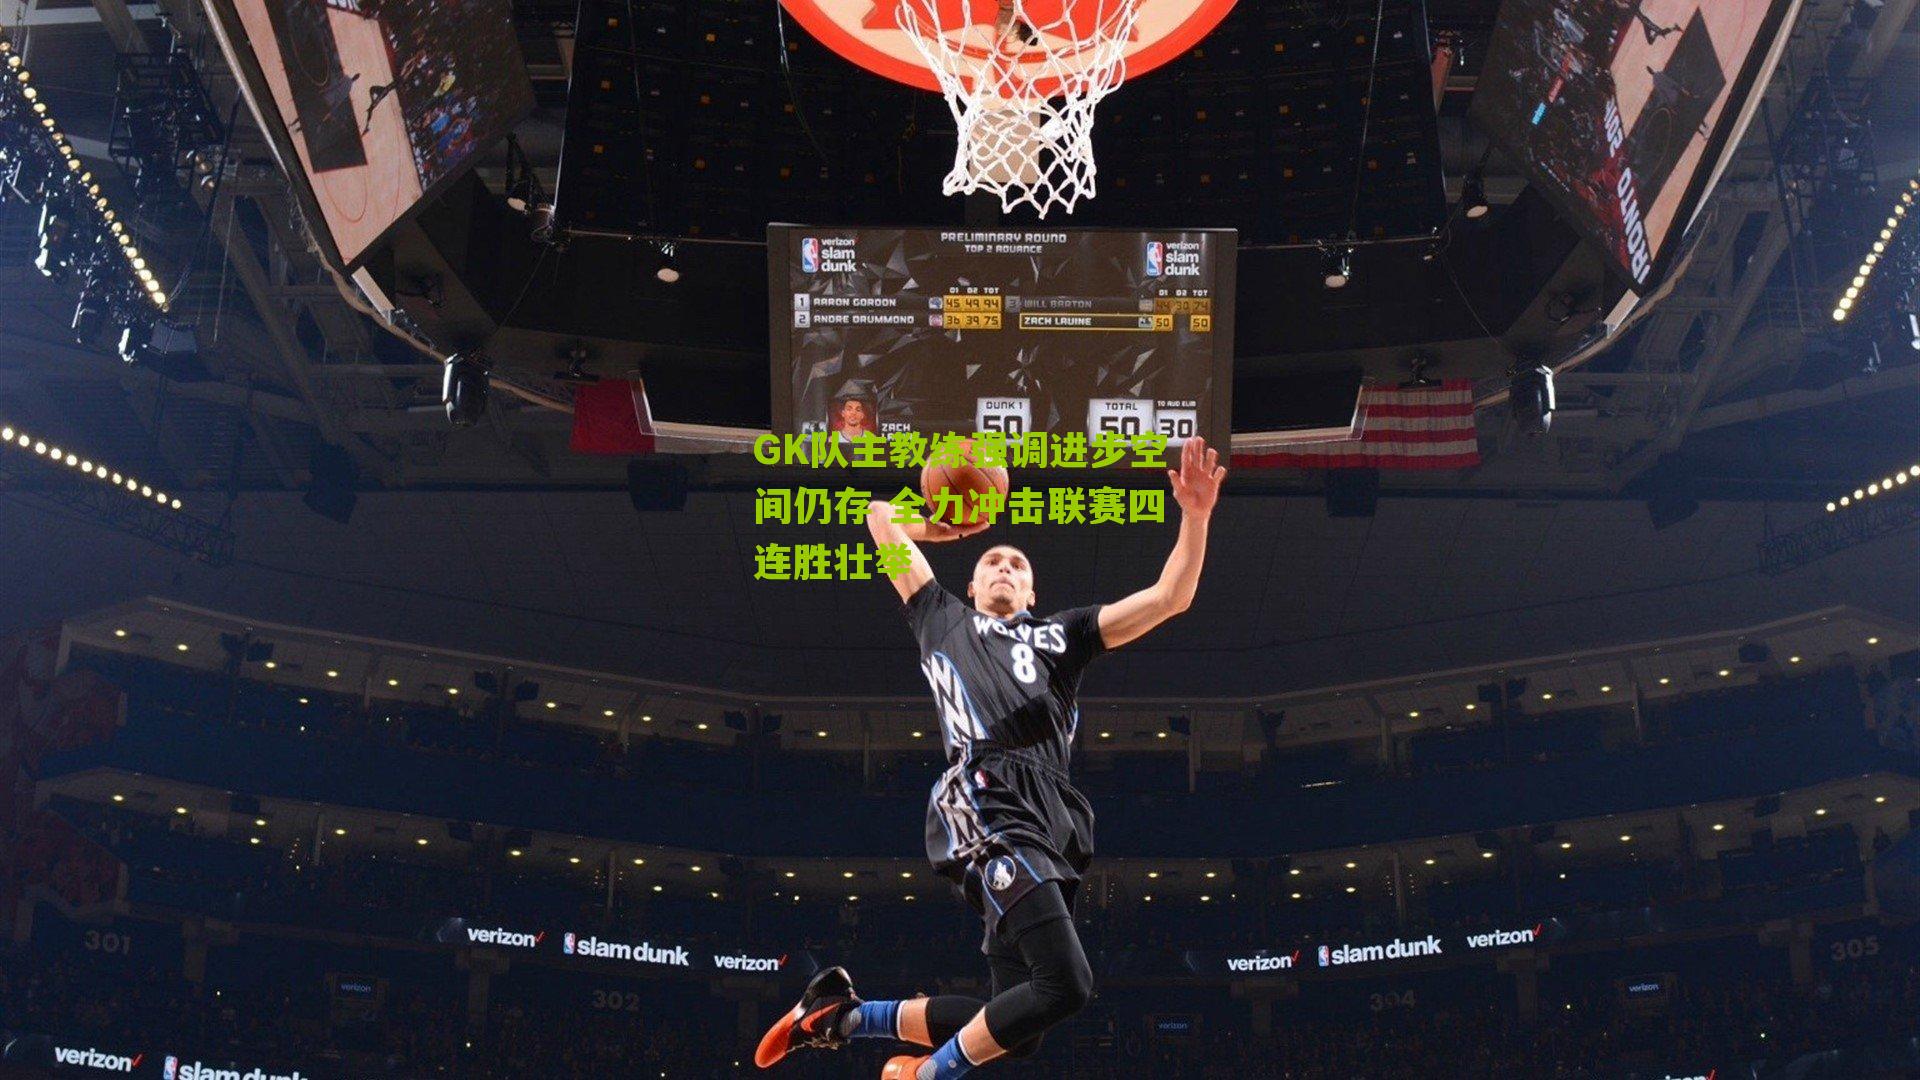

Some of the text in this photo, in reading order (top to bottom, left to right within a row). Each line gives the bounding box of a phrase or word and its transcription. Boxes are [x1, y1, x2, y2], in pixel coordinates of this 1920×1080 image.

[821, 237, 855, 246] verizon
[941, 232, 1067, 243] PRELIMINARY ROUND
[987, 245, 993, 253] 2
[996, 245, 1042, 253] ADVANCE
[1166, 241, 1199, 250] verizon
[821, 246, 855, 259] slam
[1165, 251, 1199, 263] slam
[821, 260, 857, 272] dunk
[1165, 263, 1200, 275] dunk
[813, 298, 850, 307] AARON
[853, 298, 897, 307] GORDON
[946, 299, 960, 308] 45
[966, 299, 980, 308] 49
[984, 299, 999, 308] 94
[1024, 299, 1047, 308] WILL
[1050, 300, 1092, 308] BARTON
[813, 315, 849, 324] ANDRE
[853, 315, 914, 324] DRUMMOND
[947, 316, 960, 325] 36
[966, 316, 980, 325] 39
[985, 316, 998, 325] 75
[1024, 317, 1208, 327] ZACH LAVINE 50 50
[986, 401, 1015, 411] DUNK
[1106, 402, 1138, 411] TOTAL
[882, 423, 911, 432] ZACH
[983, 415, 1023, 440] 50
[1100, 416, 1141, 441] 50
[1160, 419, 1193, 439] 30
[1011, 643, 1037, 684] 8
[84, 929, 132, 955] 301
[1830, 934, 1880, 961] 305
[467, 927, 779, 971] verizon slam dunk verizon
[1227, 928, 1534, 971] verizon slam dunk verizon
[1628, 982, 1660, 993] verizon
[592, 989, 641, 1011] 302
[1370, 988, 1417, 1013] 304
[55, 1046, 131, 1072] verizon
